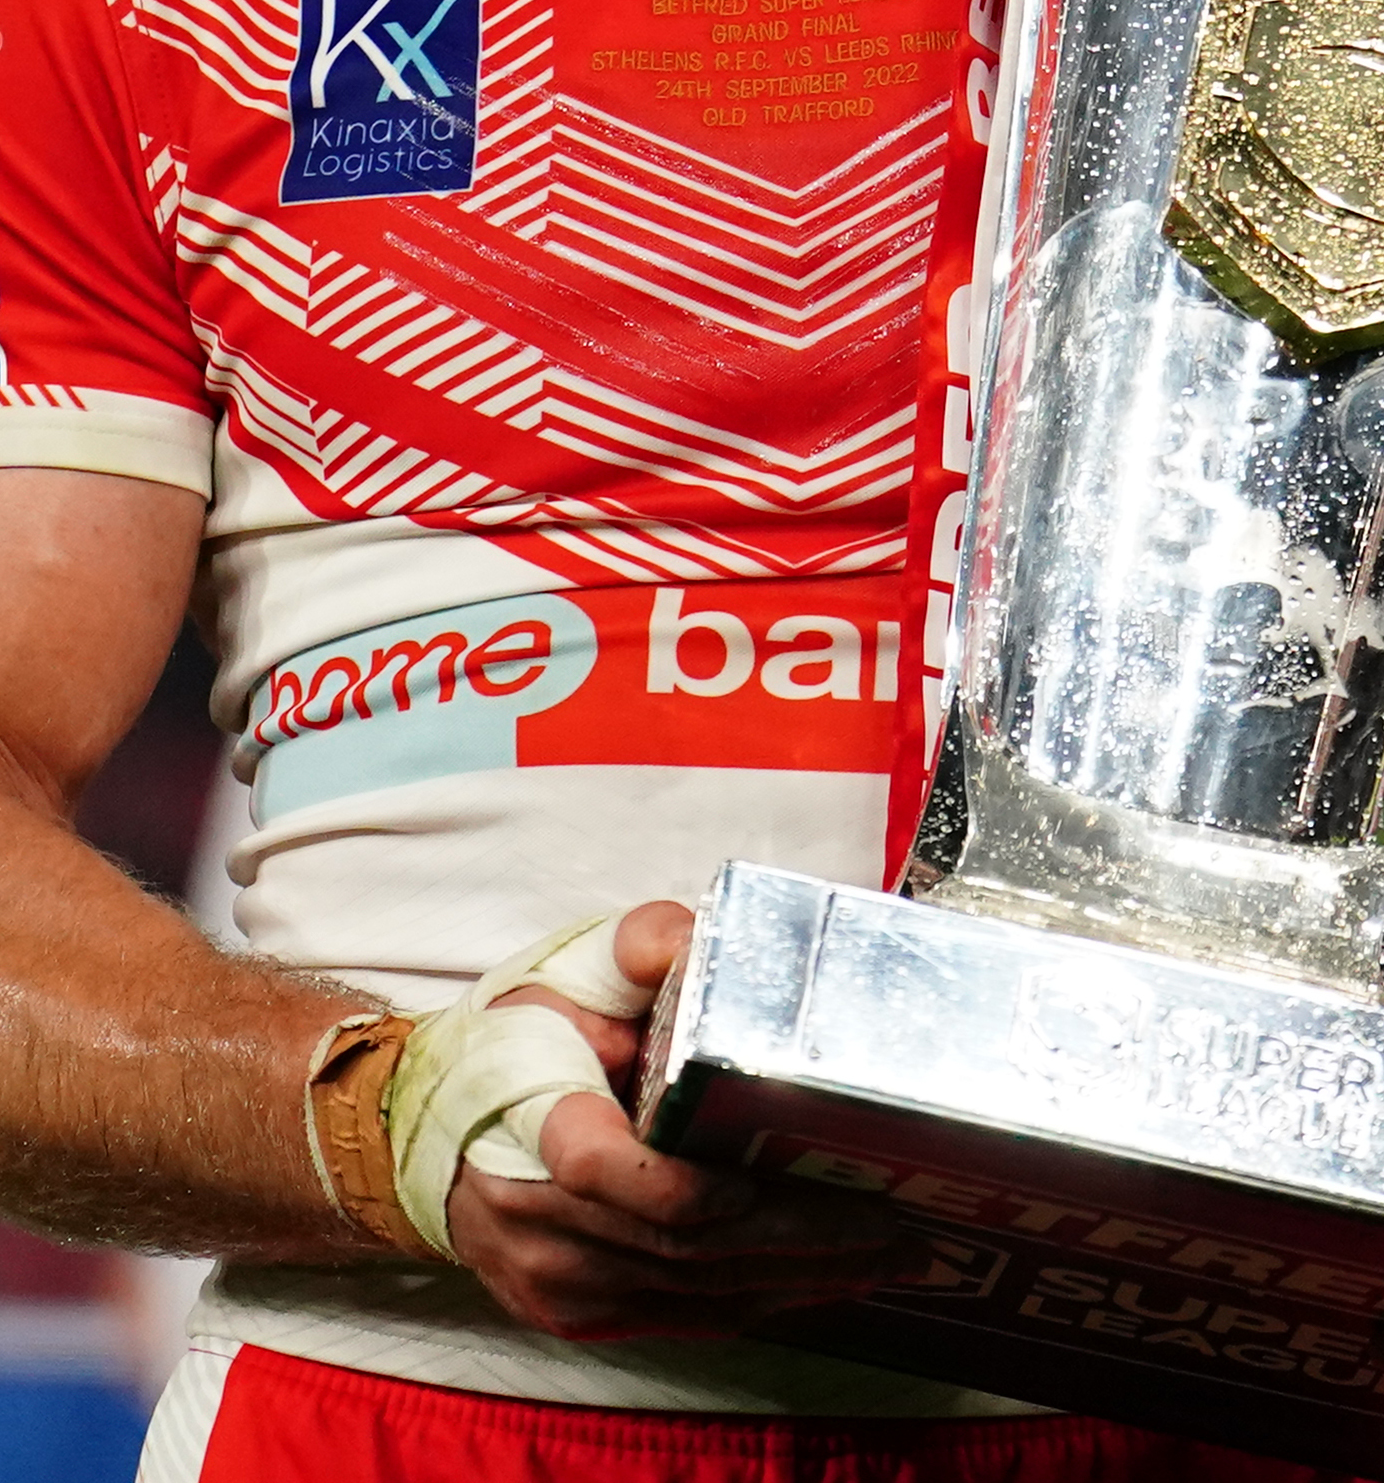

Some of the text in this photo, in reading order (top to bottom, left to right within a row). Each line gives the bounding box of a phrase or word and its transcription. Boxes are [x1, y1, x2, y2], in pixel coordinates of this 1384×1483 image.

[711, 13, 861, 44] GRAND FINAL
[784, 46, 813, 68] VS
[824, 36, 890, 63] LEEDS
[655, 62, 920, 100] 24TH SEPTEMBER 2022
[702, 97, 875, 128] OLD TRAFFORD
[310, 116, 456, 149] Kinaxia
[302, 148, 454, 183] Logistics
[253, 617, 553, 747] home
[1032, 1263, 1372, 1359] SUPE
